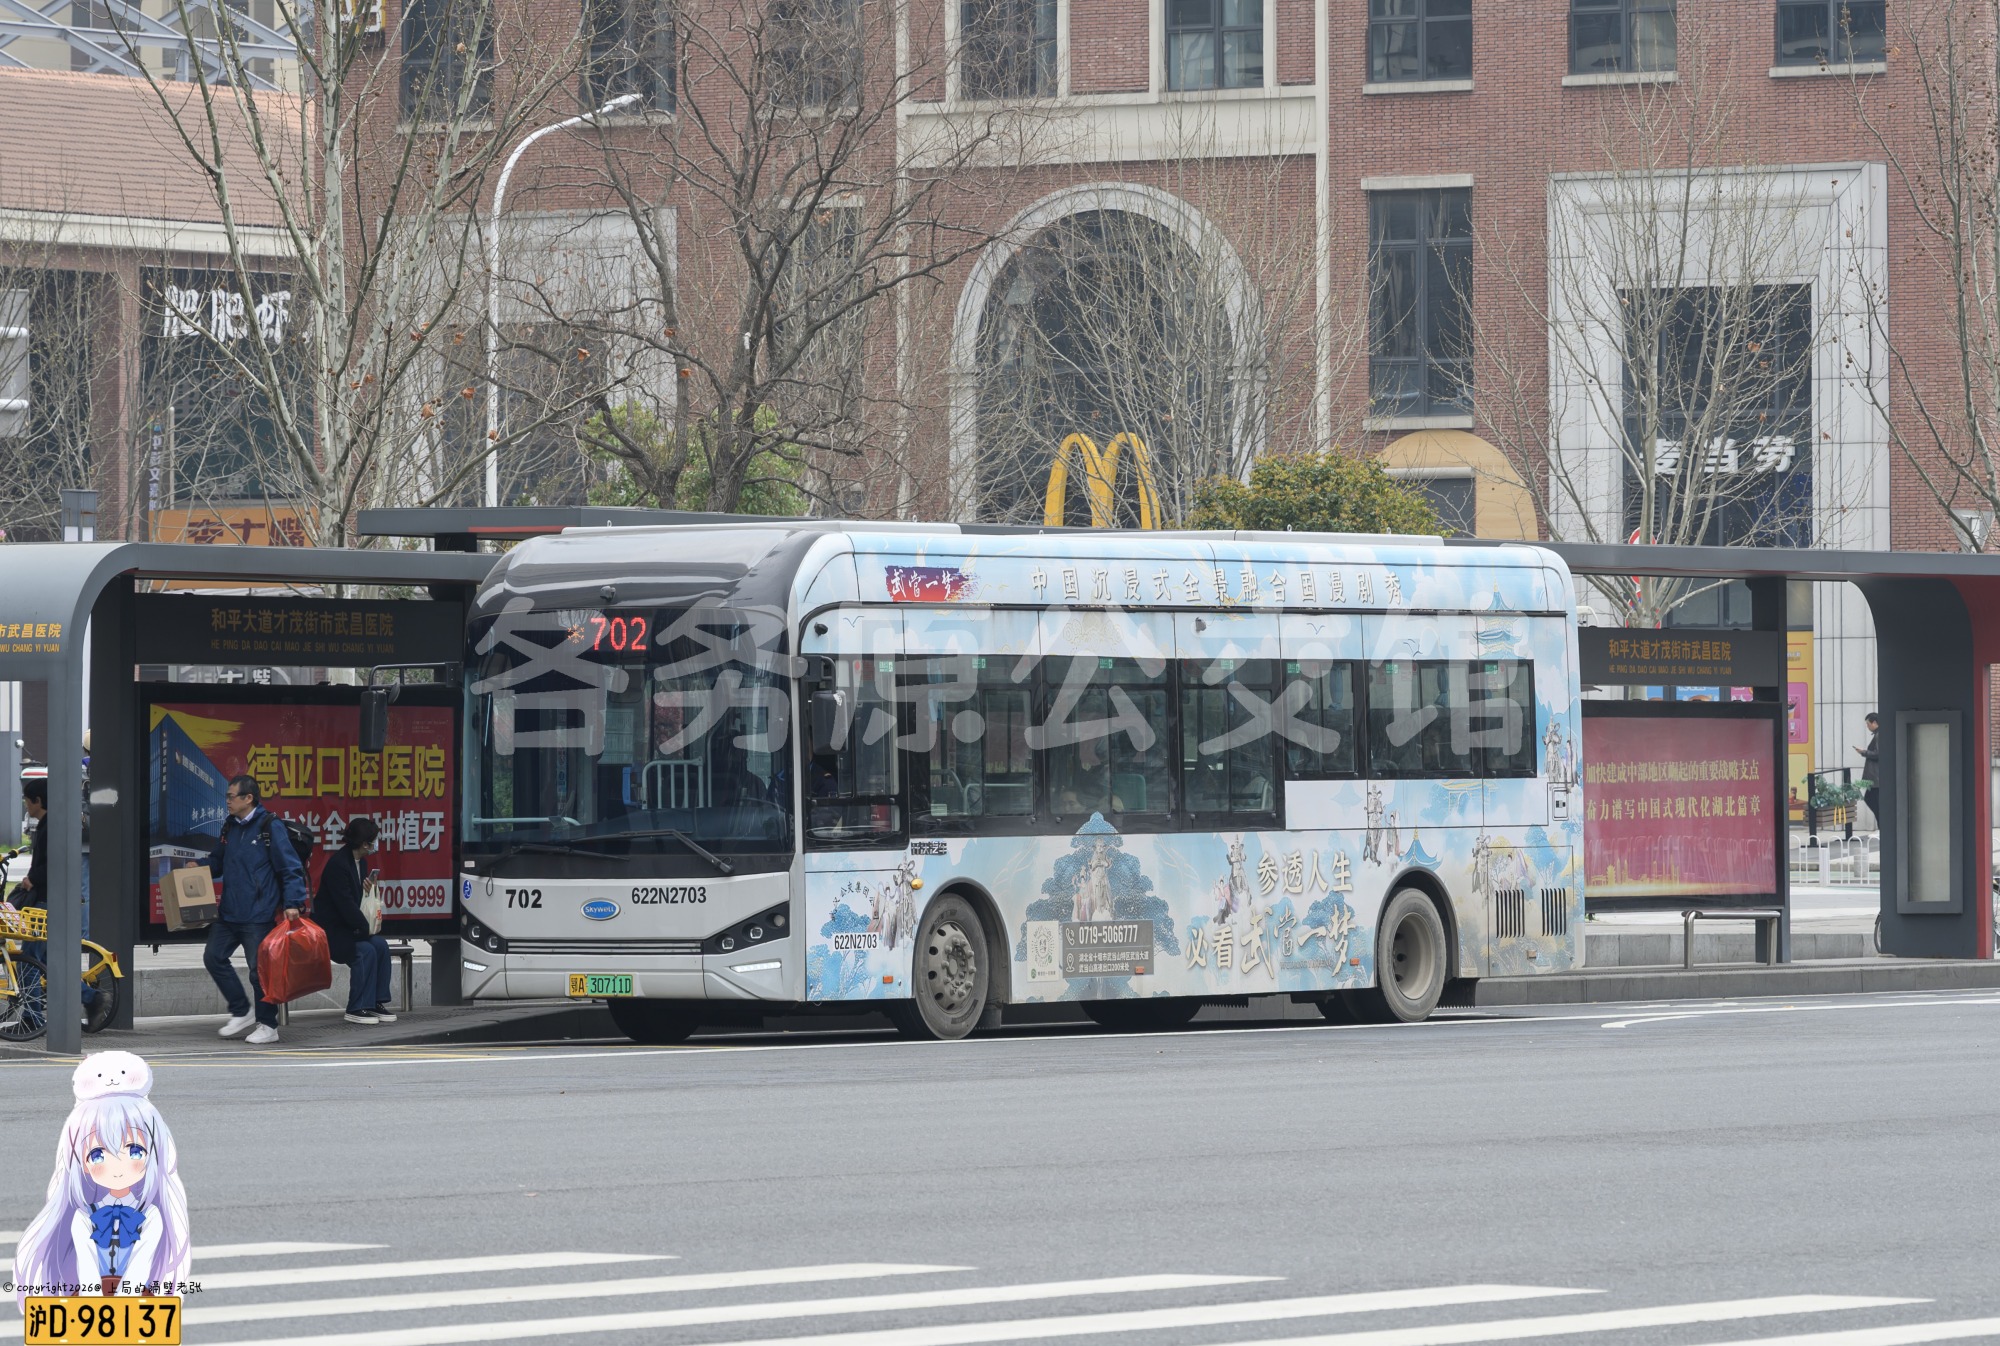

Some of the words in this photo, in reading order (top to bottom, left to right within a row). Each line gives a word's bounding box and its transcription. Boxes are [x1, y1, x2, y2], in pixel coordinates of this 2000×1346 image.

[1639, 435, 1796, 475] 麦当劳
[1030, 565, 1402, 605] 中国沉浸式全景融合国漫剧秀
[0, 622, 62, 638] 市武昌医院
[211, 608, 394, 636] 和平大道才茂街市武昌医院
[591, 617, 647, 651] 702
[12, 643, 33, 653] CHANG
[35, 643, 41, 653] YI
[43, 643, 60, 653] YUAN
[211, 639, 220, 649] HE
[223, 640, 238, 650] PING
[242, 640, 251, 650] DA
[254, 640, 268, 651] DAO
[271, 640, 282, 651] CAI
[284, 641, 299, 651] MAO
[315, 642, 325, 652] SHI
[328, 642, 339, 652] WU
[342, 642, 364, 653] CHANG
[367, 643, 374, 653] YI
[376, 643, 394, 654] YUAN
[1608, 639, 1732, 661] 和平大道才茂街市武昌医院
[246, 743, 446, 799] 德亚口腔医院
[1586, 759, 1760, 784] 加快建成中部地区崛起的重要战略支点
[1586, 795, 1761, 821] 奋力谱写中国式现代化湖北篇章
[1256, 850, 1353, 896] 参透人生
[407, 885, 445, 908] 9999
[505, 889, 543, 909] 702
[631, 886, 707, 905] 622N2703
[834, 934, 878, 950] 622N2703
[1078, 924, 1138, 945] 0719-5066777
